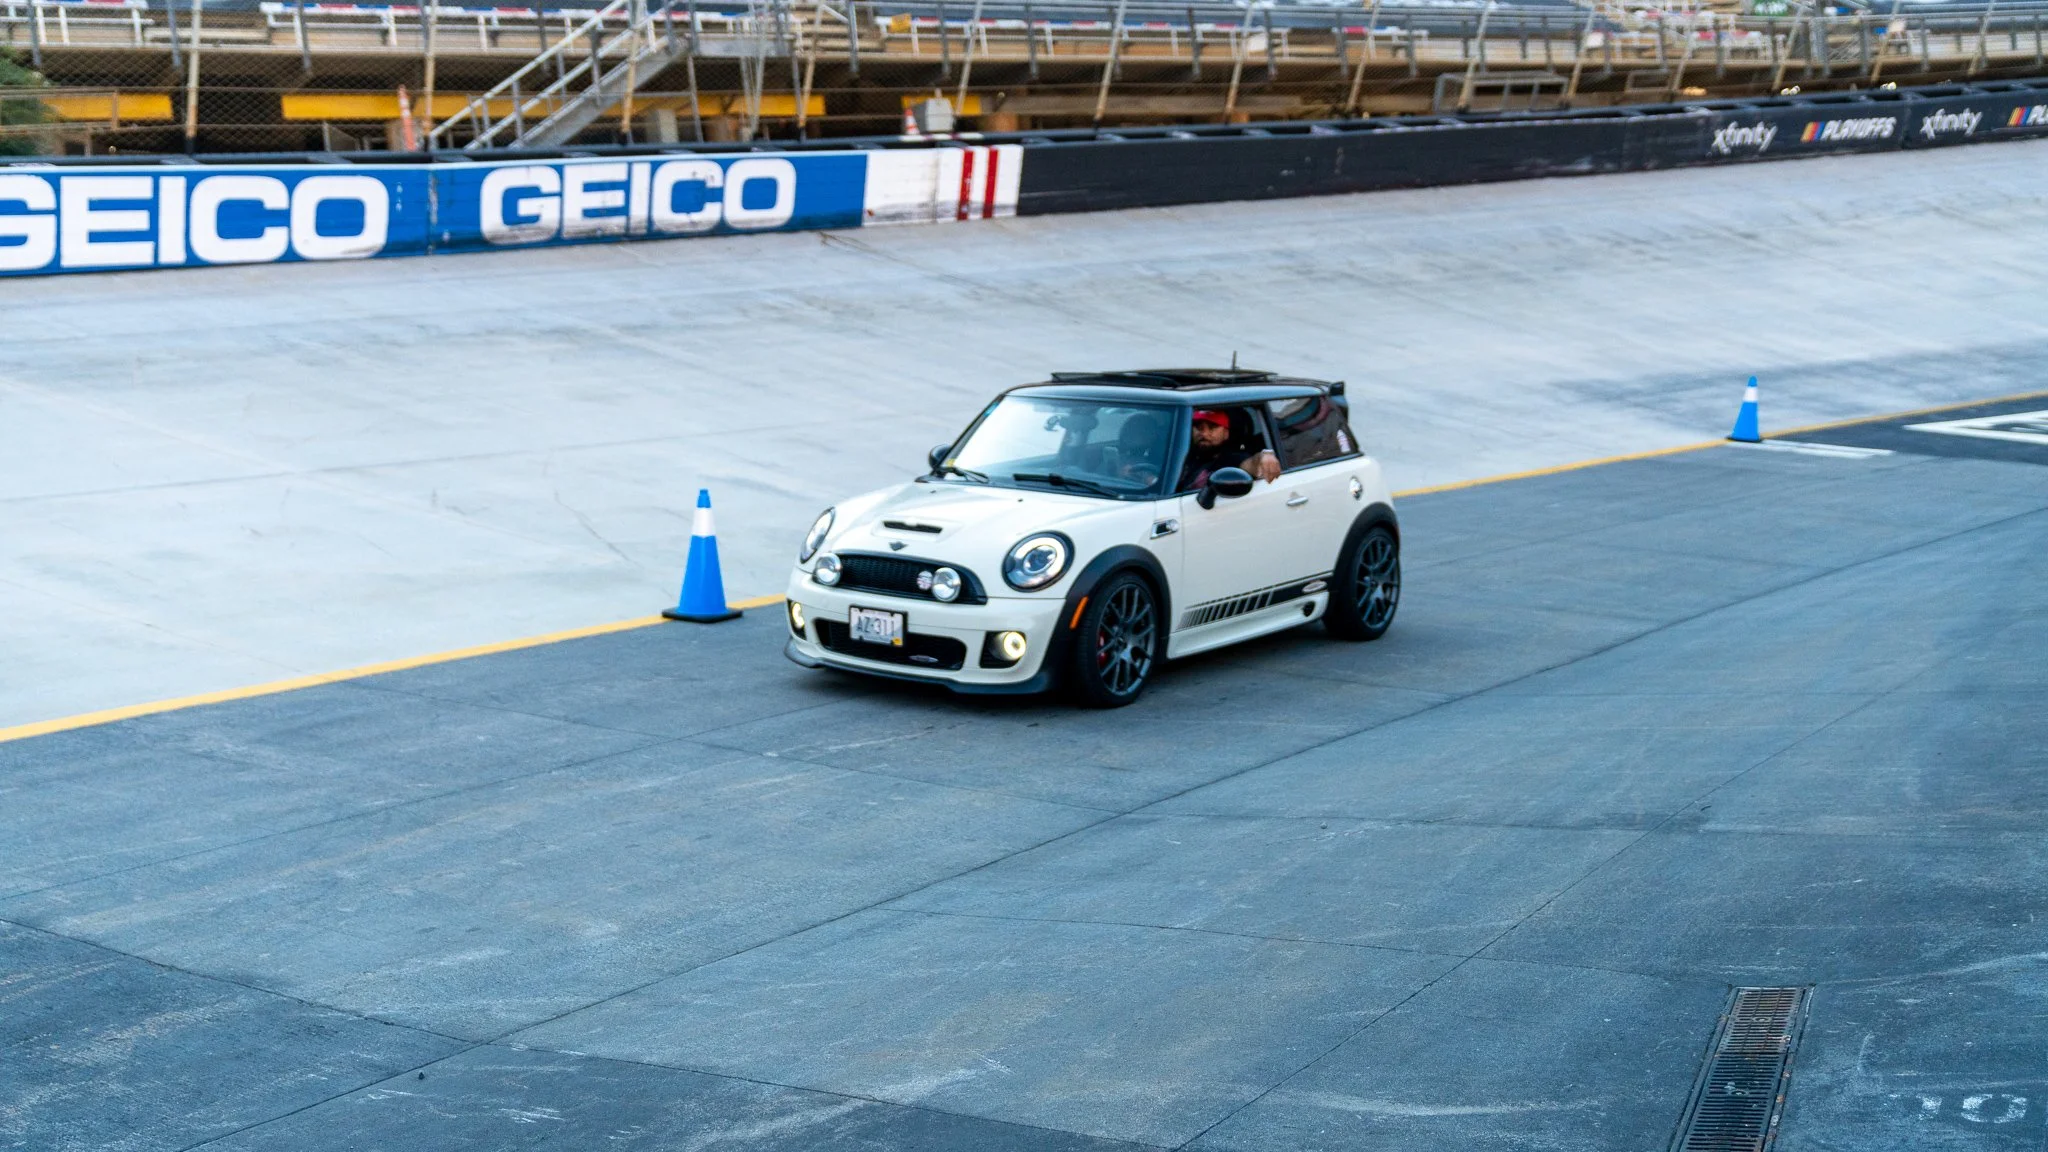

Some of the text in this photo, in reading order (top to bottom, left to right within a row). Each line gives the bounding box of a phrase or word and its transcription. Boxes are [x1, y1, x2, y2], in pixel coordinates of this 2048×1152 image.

[1711, 116, 1897, 154] xfinity PLAYOFFS
[1919, 107, 1982, 140] xfinity
[480, 158, 797, 246] GEICO
